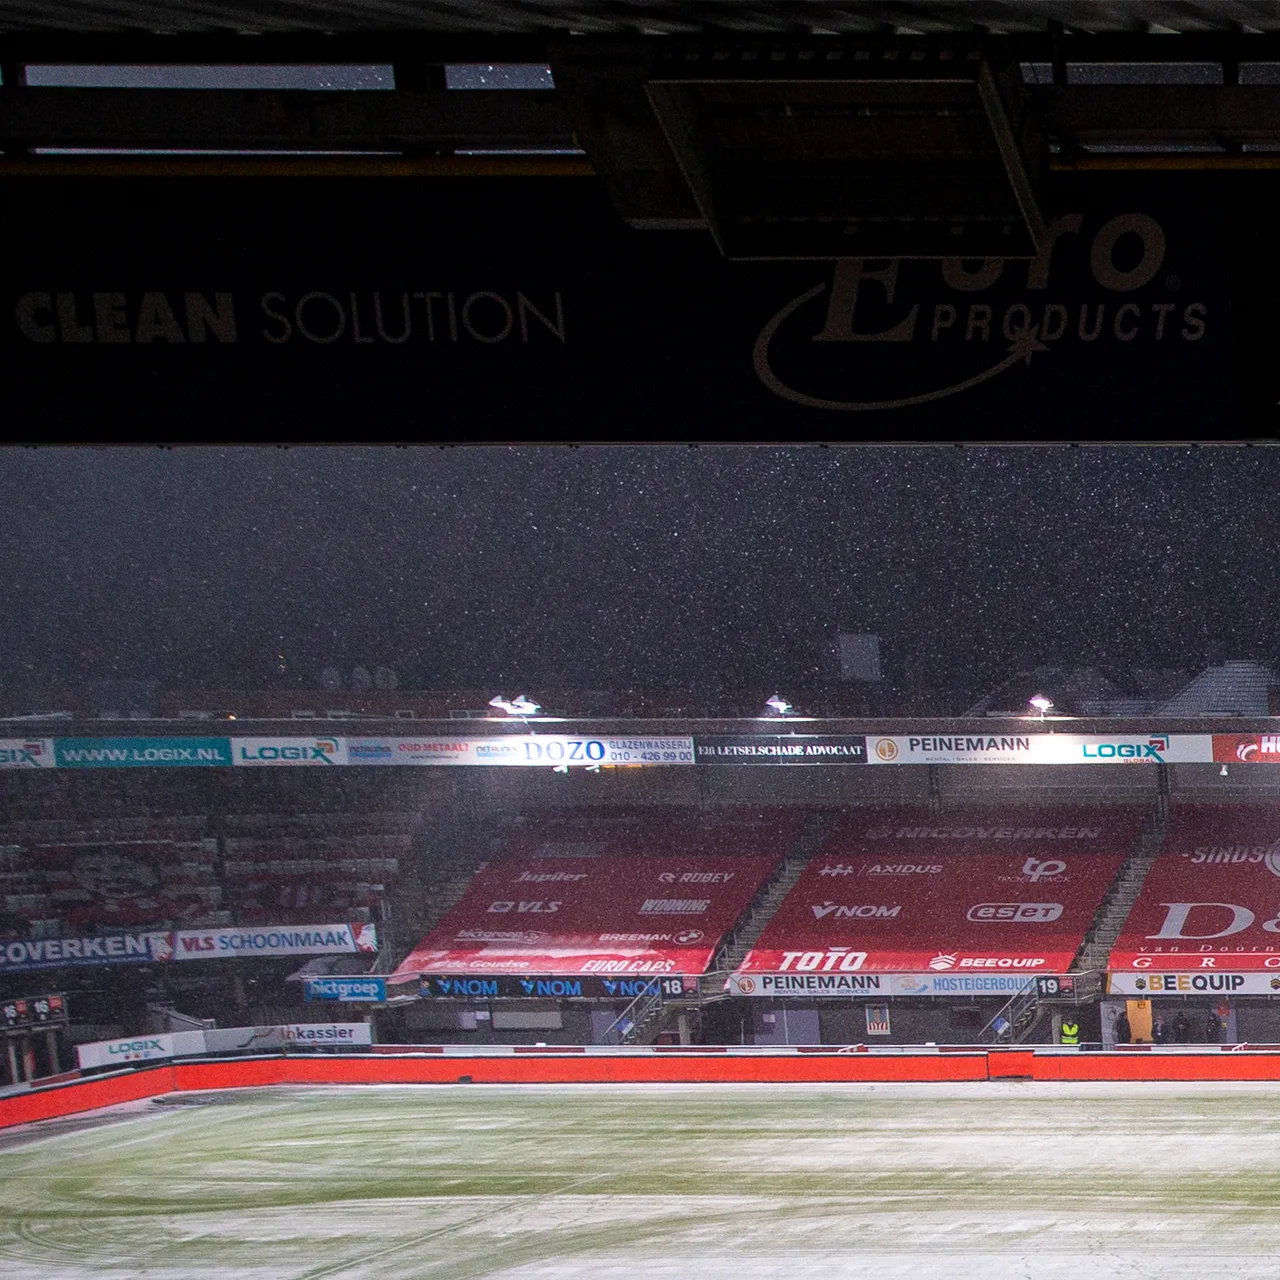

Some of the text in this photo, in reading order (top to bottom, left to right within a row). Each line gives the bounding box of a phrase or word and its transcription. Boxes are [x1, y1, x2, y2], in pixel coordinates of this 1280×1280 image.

[14, 290, 568, 345] CLEAN SOLUTION
[930, 302, 1208, 342] PRODUCTS
[523, 740, 606, 761] DOZO
[609, 740, 693, 750] GLAZENWASSERIJ
[717, 745, 863, 756] LETSELSCHADE ADVOCAAT
[909, 737, 1031, 752] PEINEMANN
[62, 747, 225, 762] WWW.LOGIX.NL
[241, 745, 335, 764] LOGIX
[611, 751, 693, 761] 010 426 99 00
[1082, 744, 1161, 762] LOGIX
[1190, 846, 1266, 863] SINDS
[867, 864, 944, 874] AXIDUS
[516, 871, 588, 883] Jupiler
[517, 901, 563, 913] VLS
[639, 899, 712, 912] WOONING
[834, 905, 902, 918] NOM
[180, 930, 349, 951] VLS SCHOONMAAK
[599, 933, 672, 941] BREEMAN
[1139, 944, 1179, 952] van
[1199, 943, 1274, 952] Doorn
[448, 960, 530, 968] de Goudse
[580, 960, 676, 972] EURO CAPS
[959, 957, 1045, 967] BEEQUIP
[454, 979, 498, 995] NOM
[536, 979, 582, 995] NOM
[663, 979, 683, 995] 18
[762, 976, 881, 989] PEINEMANN
[1038, 979, 1057, 993] 19
[1148, 974, 1245, 991] BEEQUIP
[107, 1038, 165, 1055] LOGIX
